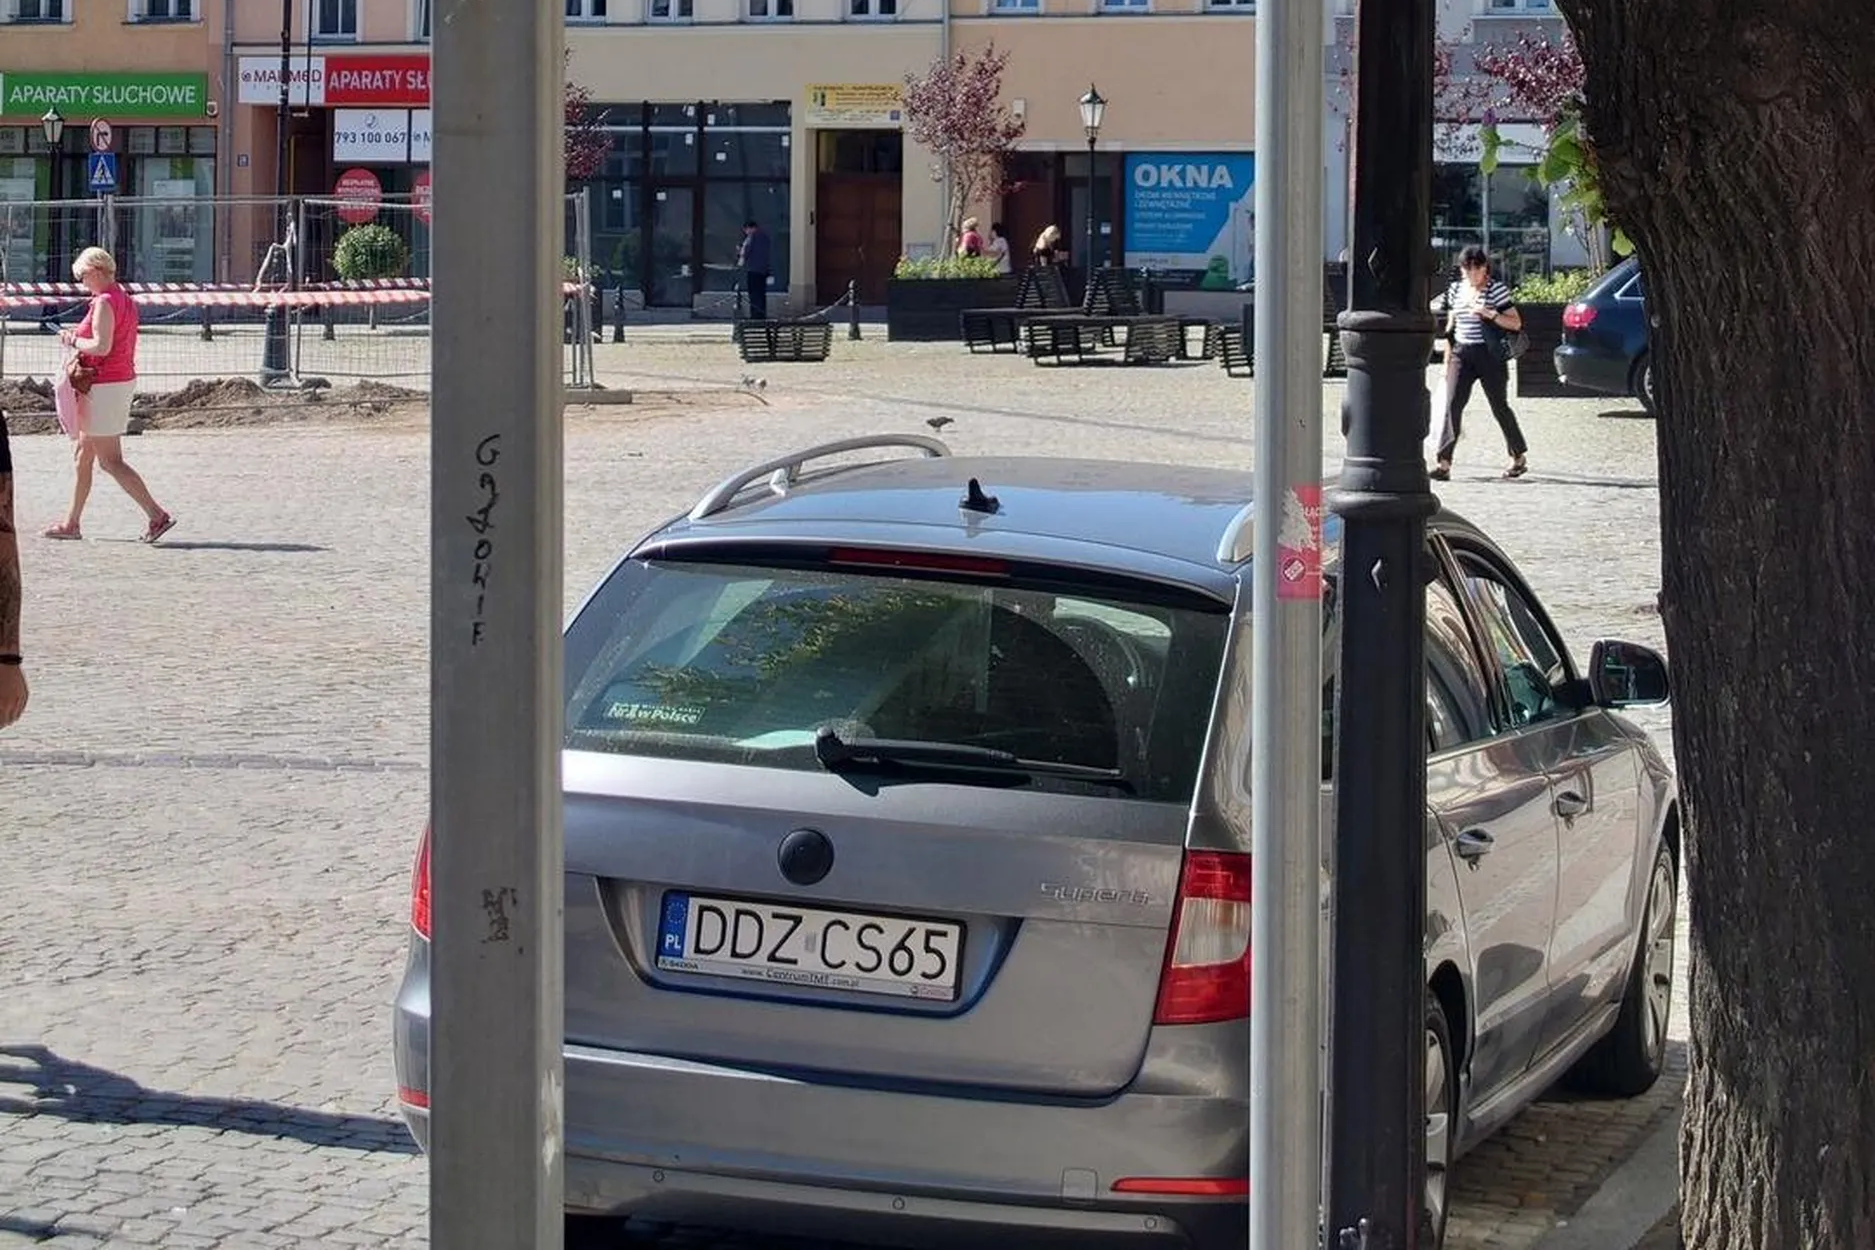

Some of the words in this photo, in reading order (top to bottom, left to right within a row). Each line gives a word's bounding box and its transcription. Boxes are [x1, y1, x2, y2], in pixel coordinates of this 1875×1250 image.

[328, 70, 402, 90] APARATY
[406, 70, 430, 90] SŁ
[10, 85, 91, 103] APARATY
[92, 85, 196, 103] SŁUCHOWE
[335, 131, 357, 144] 793
[361, 131, 381, 143] 100
[384, 131, 407, 144] 067
[1133, 163, 1234, 188] OKNA
[664, 933, 681, 949] PL
[693, 904, 803, 965] DDZ
[820, 919, 949, 980] CS65
